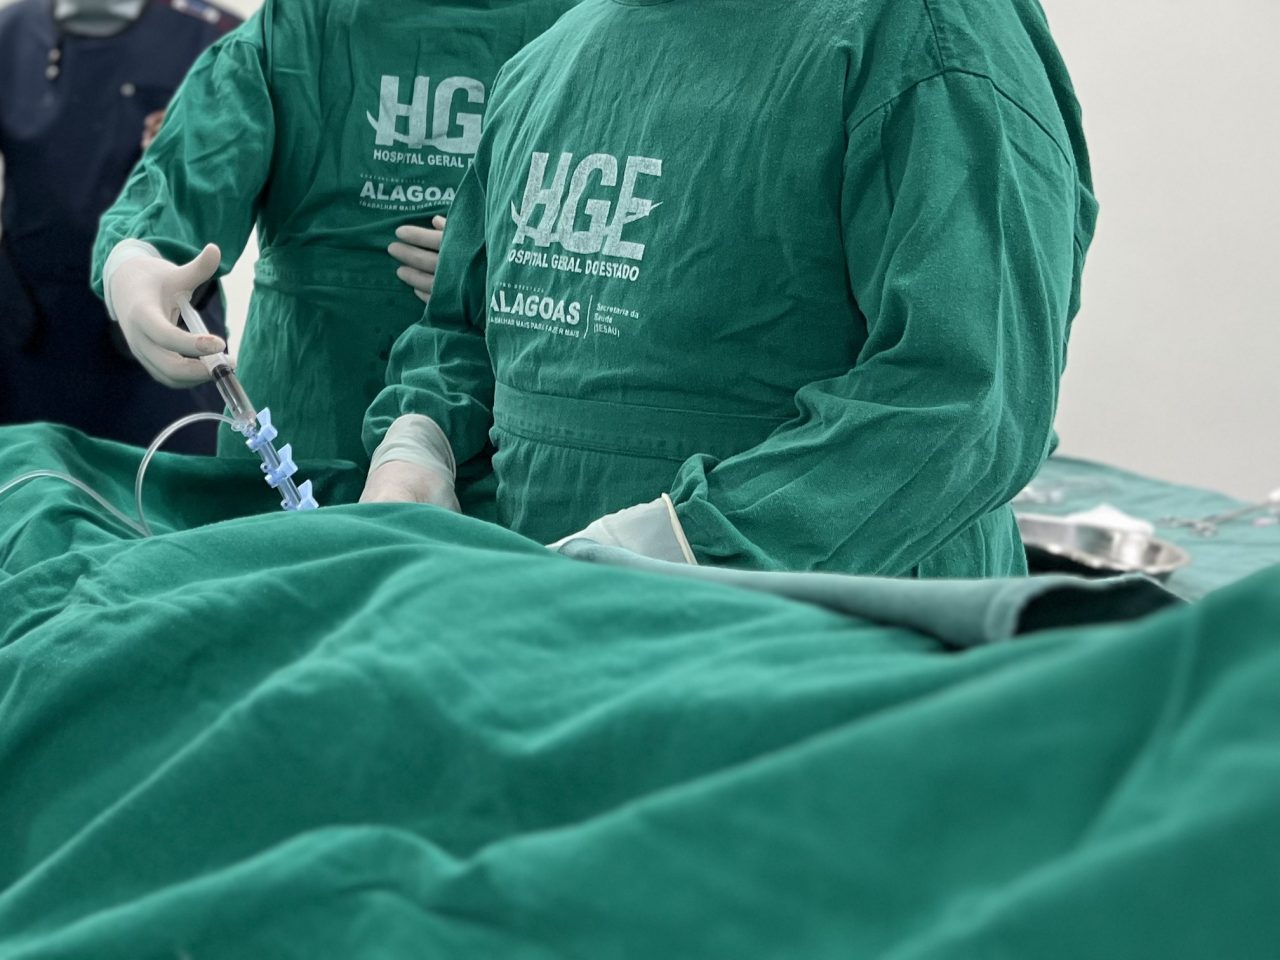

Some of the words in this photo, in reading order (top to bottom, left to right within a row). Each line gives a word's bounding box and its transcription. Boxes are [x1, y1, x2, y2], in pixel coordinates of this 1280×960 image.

[367, 74, 485, 154] HG
[373, 149, 425, 165] HOSPITAL
[427, 154, 465, 168] GERAL
[360, 180, 456, 202] ALAGOA
[510, 151, 663, 260] HGE
[508, 249, 549, 268] OSPITAL
[551, 253, 583, 273] GERAL
